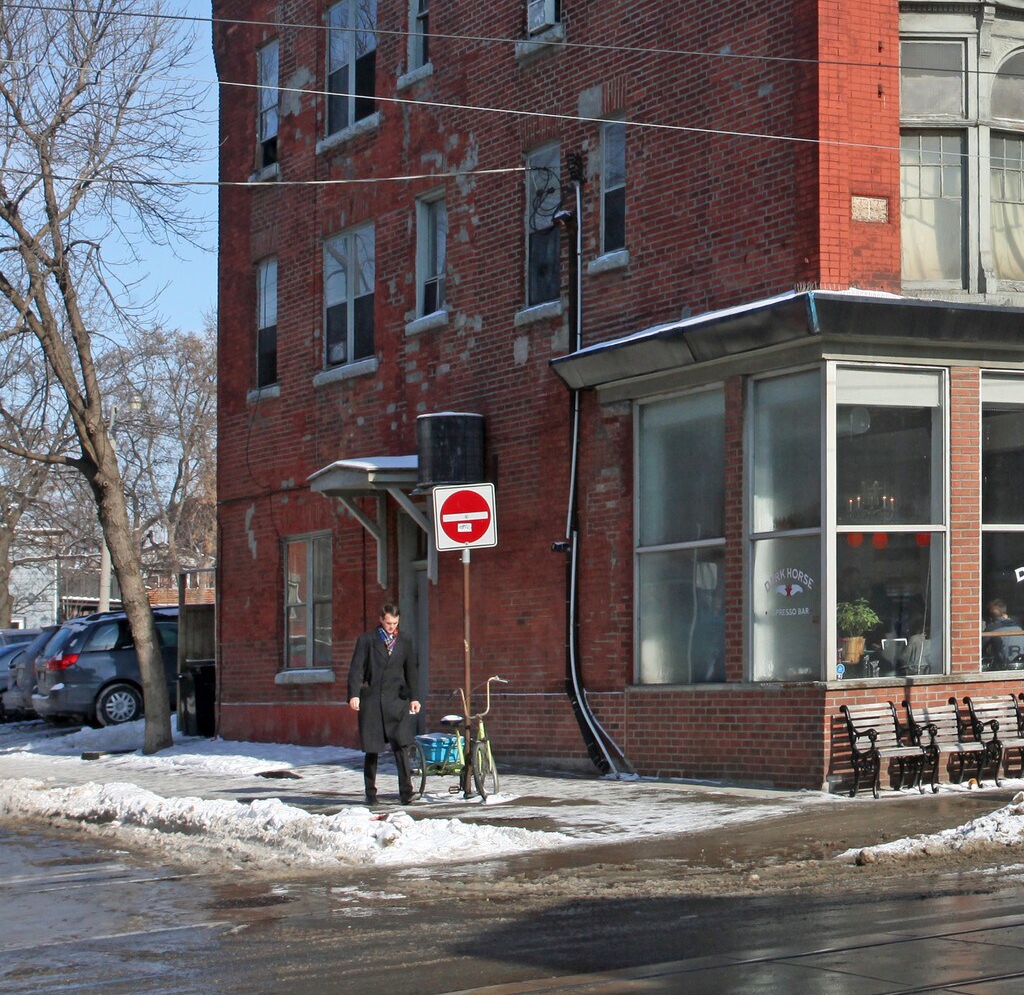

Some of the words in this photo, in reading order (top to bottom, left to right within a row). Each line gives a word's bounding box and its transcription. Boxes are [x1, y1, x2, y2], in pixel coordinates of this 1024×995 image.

[786, 567, 814, 590] HORSE
[774, 608, 797, 616] PRESSO
[797, 607, 810, 615] BAR
